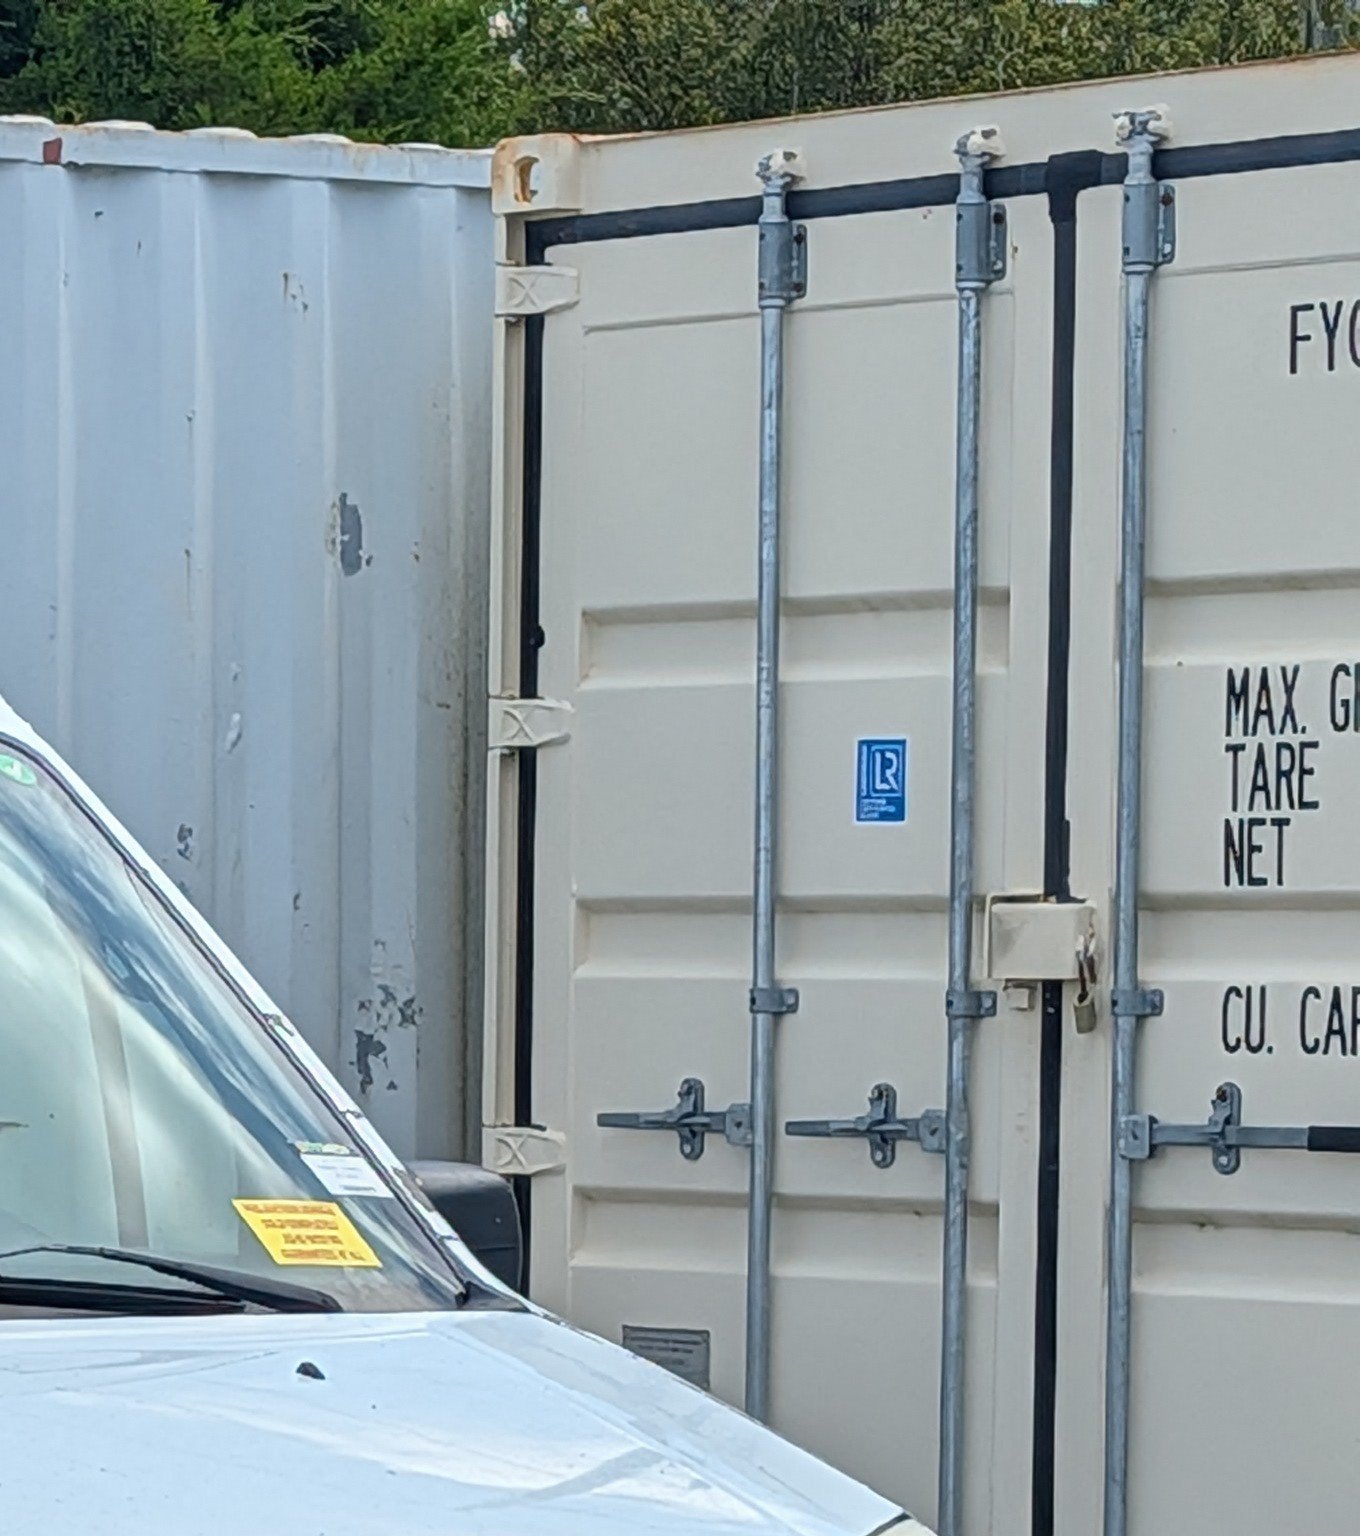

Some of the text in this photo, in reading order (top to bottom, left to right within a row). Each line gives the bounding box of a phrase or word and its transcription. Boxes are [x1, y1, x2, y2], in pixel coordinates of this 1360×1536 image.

[1225, 664, 1307, 737] MAX.
[874, 750, 899, 791] LR
[1224, 740, 1320, 813] TARE
[1223, 816, 1292, 888] NET
[1221, 984, 1274, 1055] CU.
